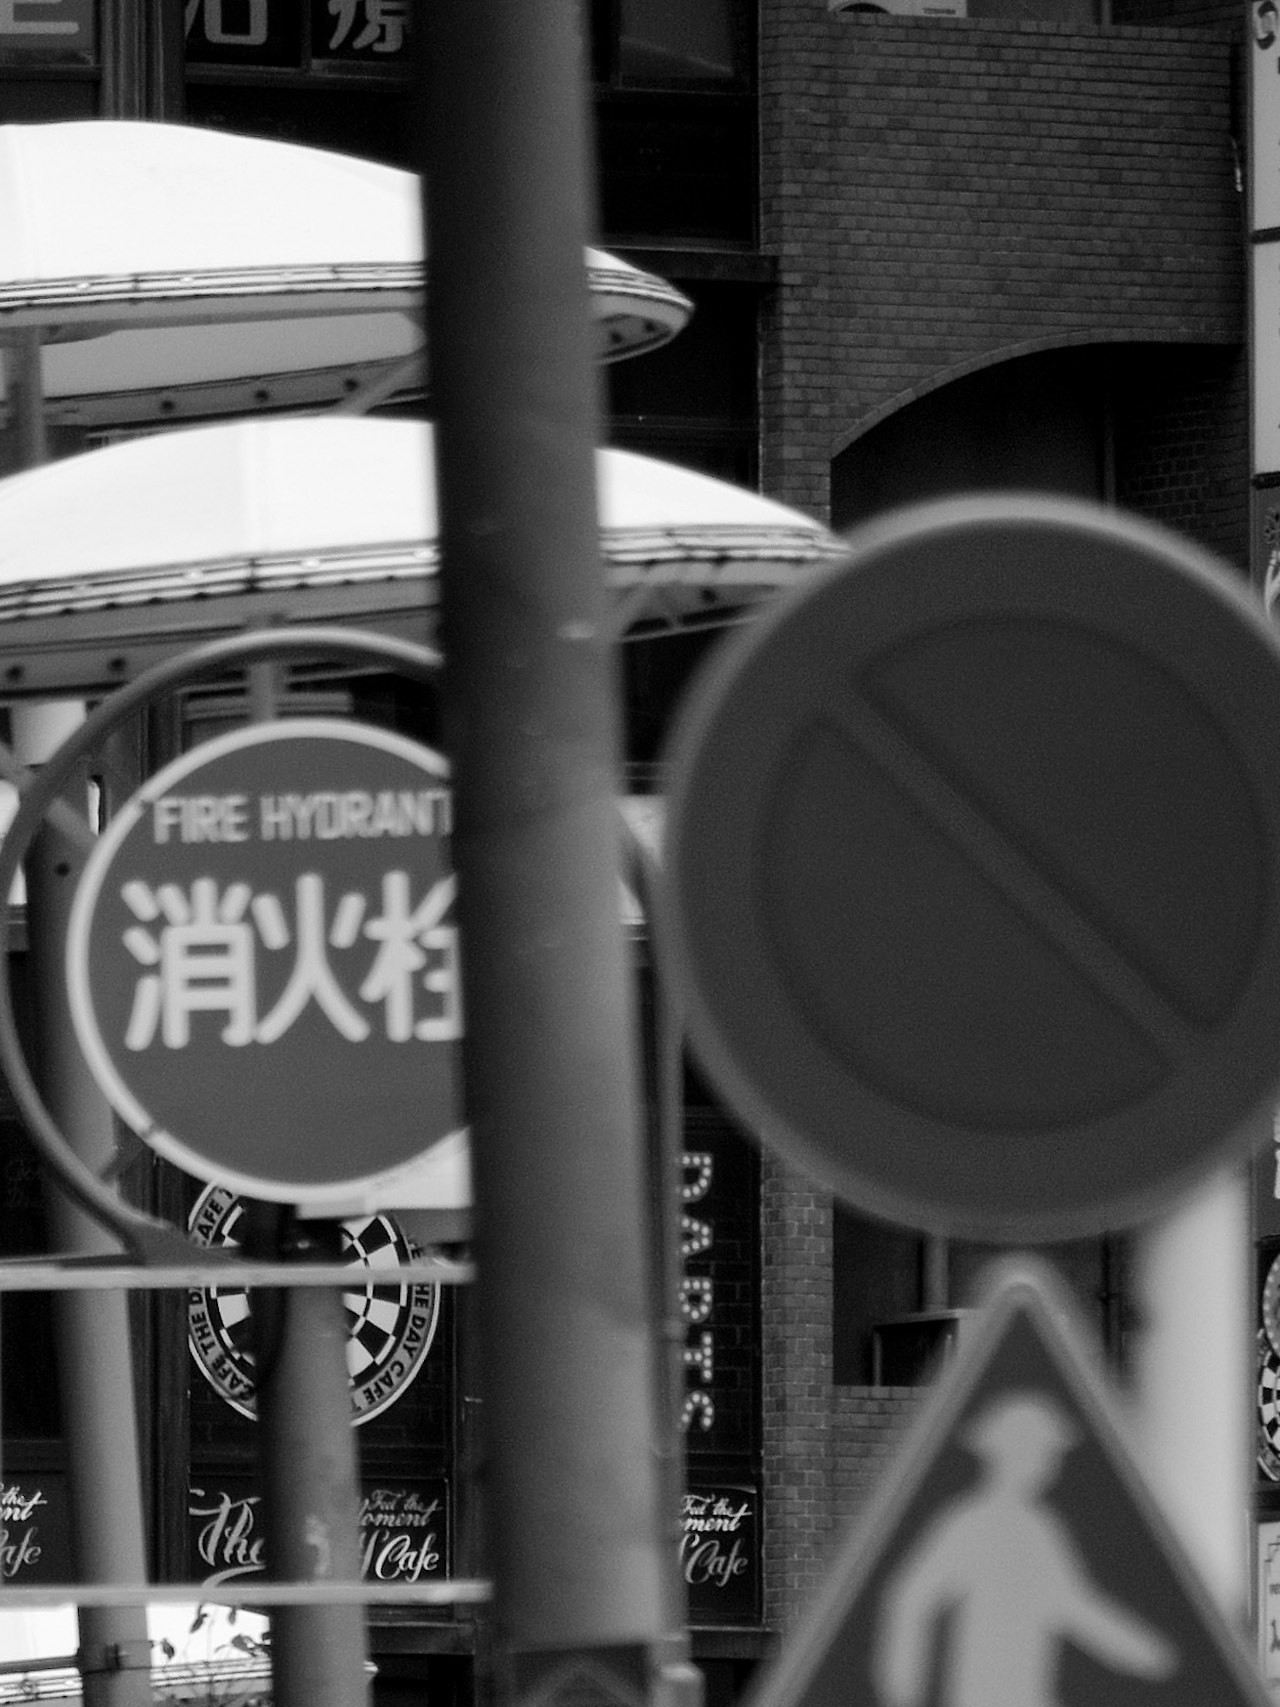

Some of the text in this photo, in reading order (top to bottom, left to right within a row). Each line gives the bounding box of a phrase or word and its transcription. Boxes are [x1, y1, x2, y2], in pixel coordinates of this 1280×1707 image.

[151, 788, 454, 844] FIRE HYDRANT
[374, 1532, 440, 1583] Cafe
[686, 1538, 749, 1588] Cafe
